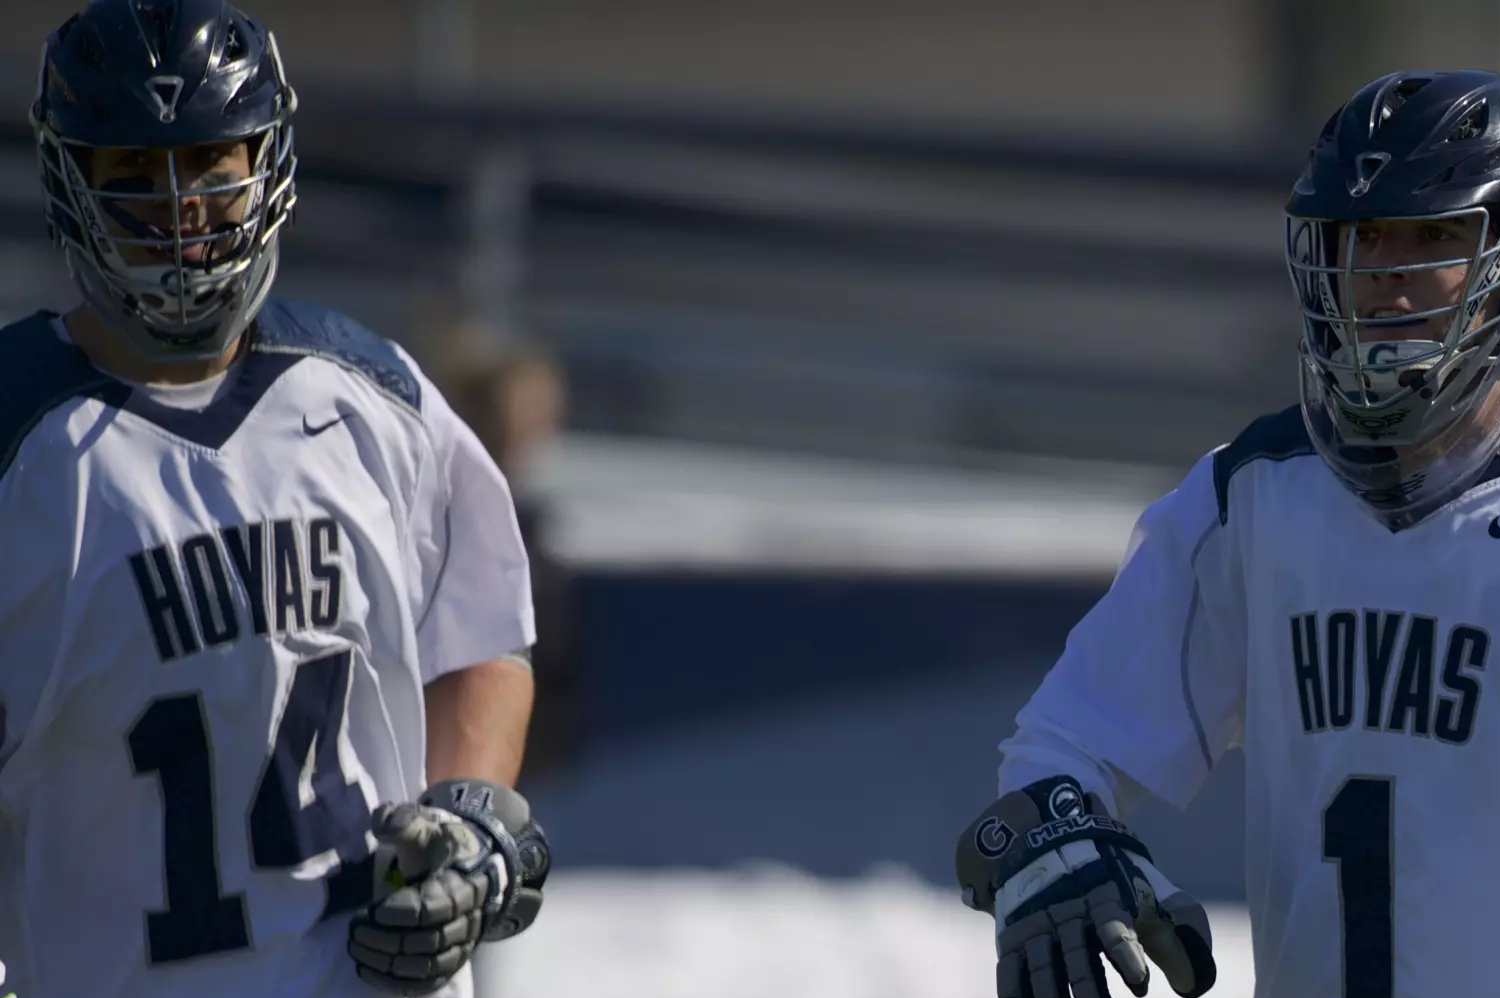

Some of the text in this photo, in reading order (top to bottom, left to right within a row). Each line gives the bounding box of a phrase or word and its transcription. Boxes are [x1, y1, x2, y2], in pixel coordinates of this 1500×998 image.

[128, 517, 346, 664] HOYAS
[1289, 606, 1491, 748] HOYAS
[124, 646, 378, 969] 14
[974, 815, 1019, 860] G
[1024, 813, 1128, 849] MAVER
